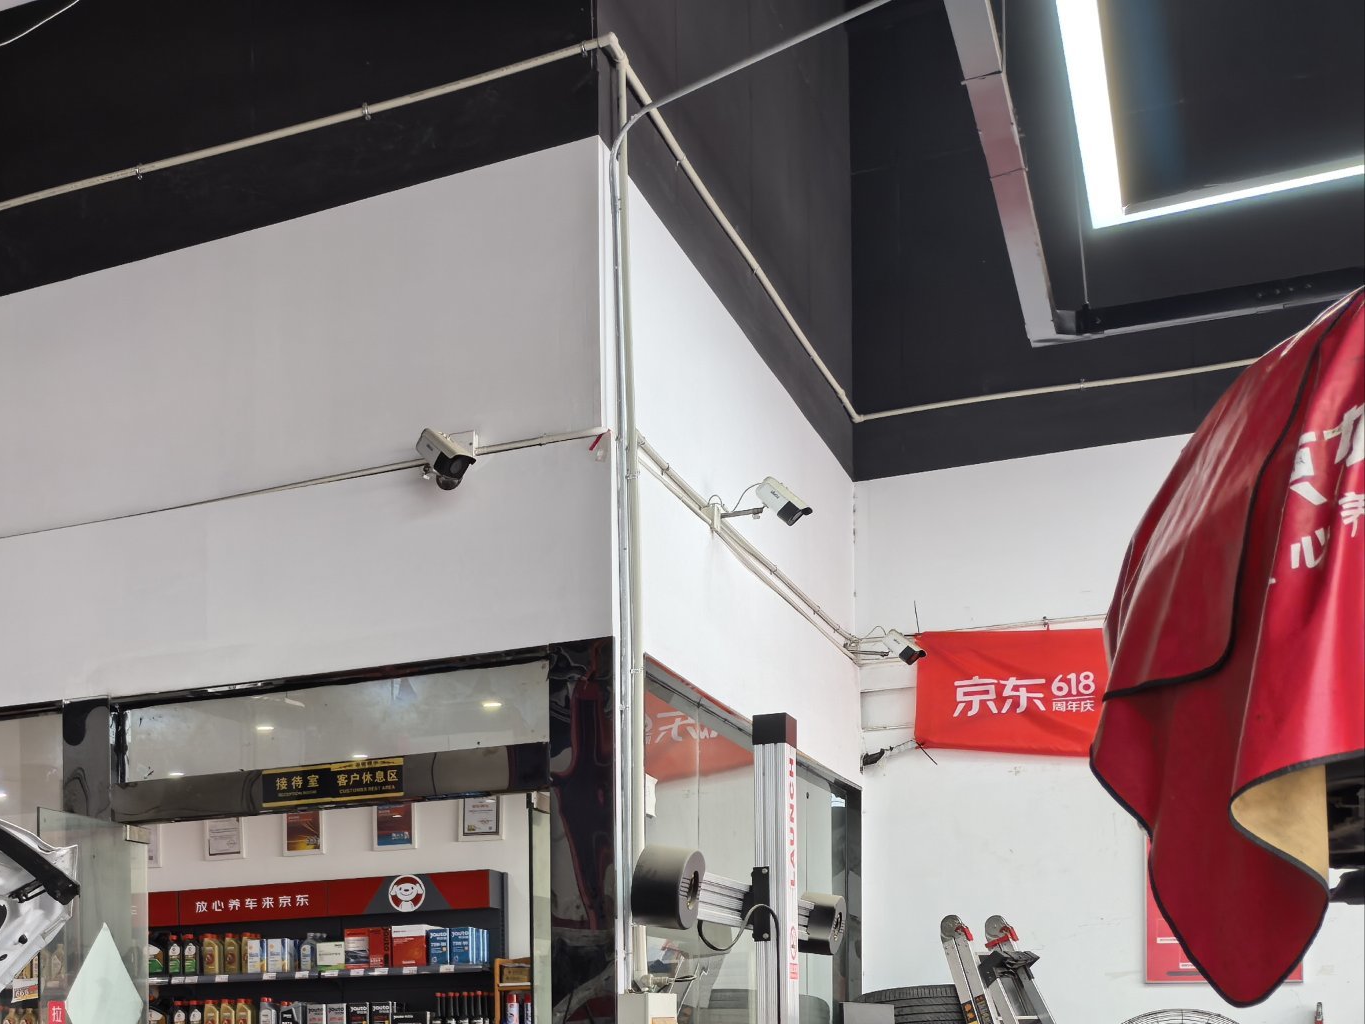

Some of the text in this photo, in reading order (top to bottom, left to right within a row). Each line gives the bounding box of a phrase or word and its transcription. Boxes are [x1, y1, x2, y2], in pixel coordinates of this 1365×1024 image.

[953, 671, 1096, 717] 京东 618
[1052, 700, 1095, 712] 周年庆
[275, 769, 399, 791] 接待室 客户休息区
[788, 757, 796, 888] LAUNCH
[195, 894, 310, 914] 放心养车来京东
[51, 1005, 62, 1023] 拉
